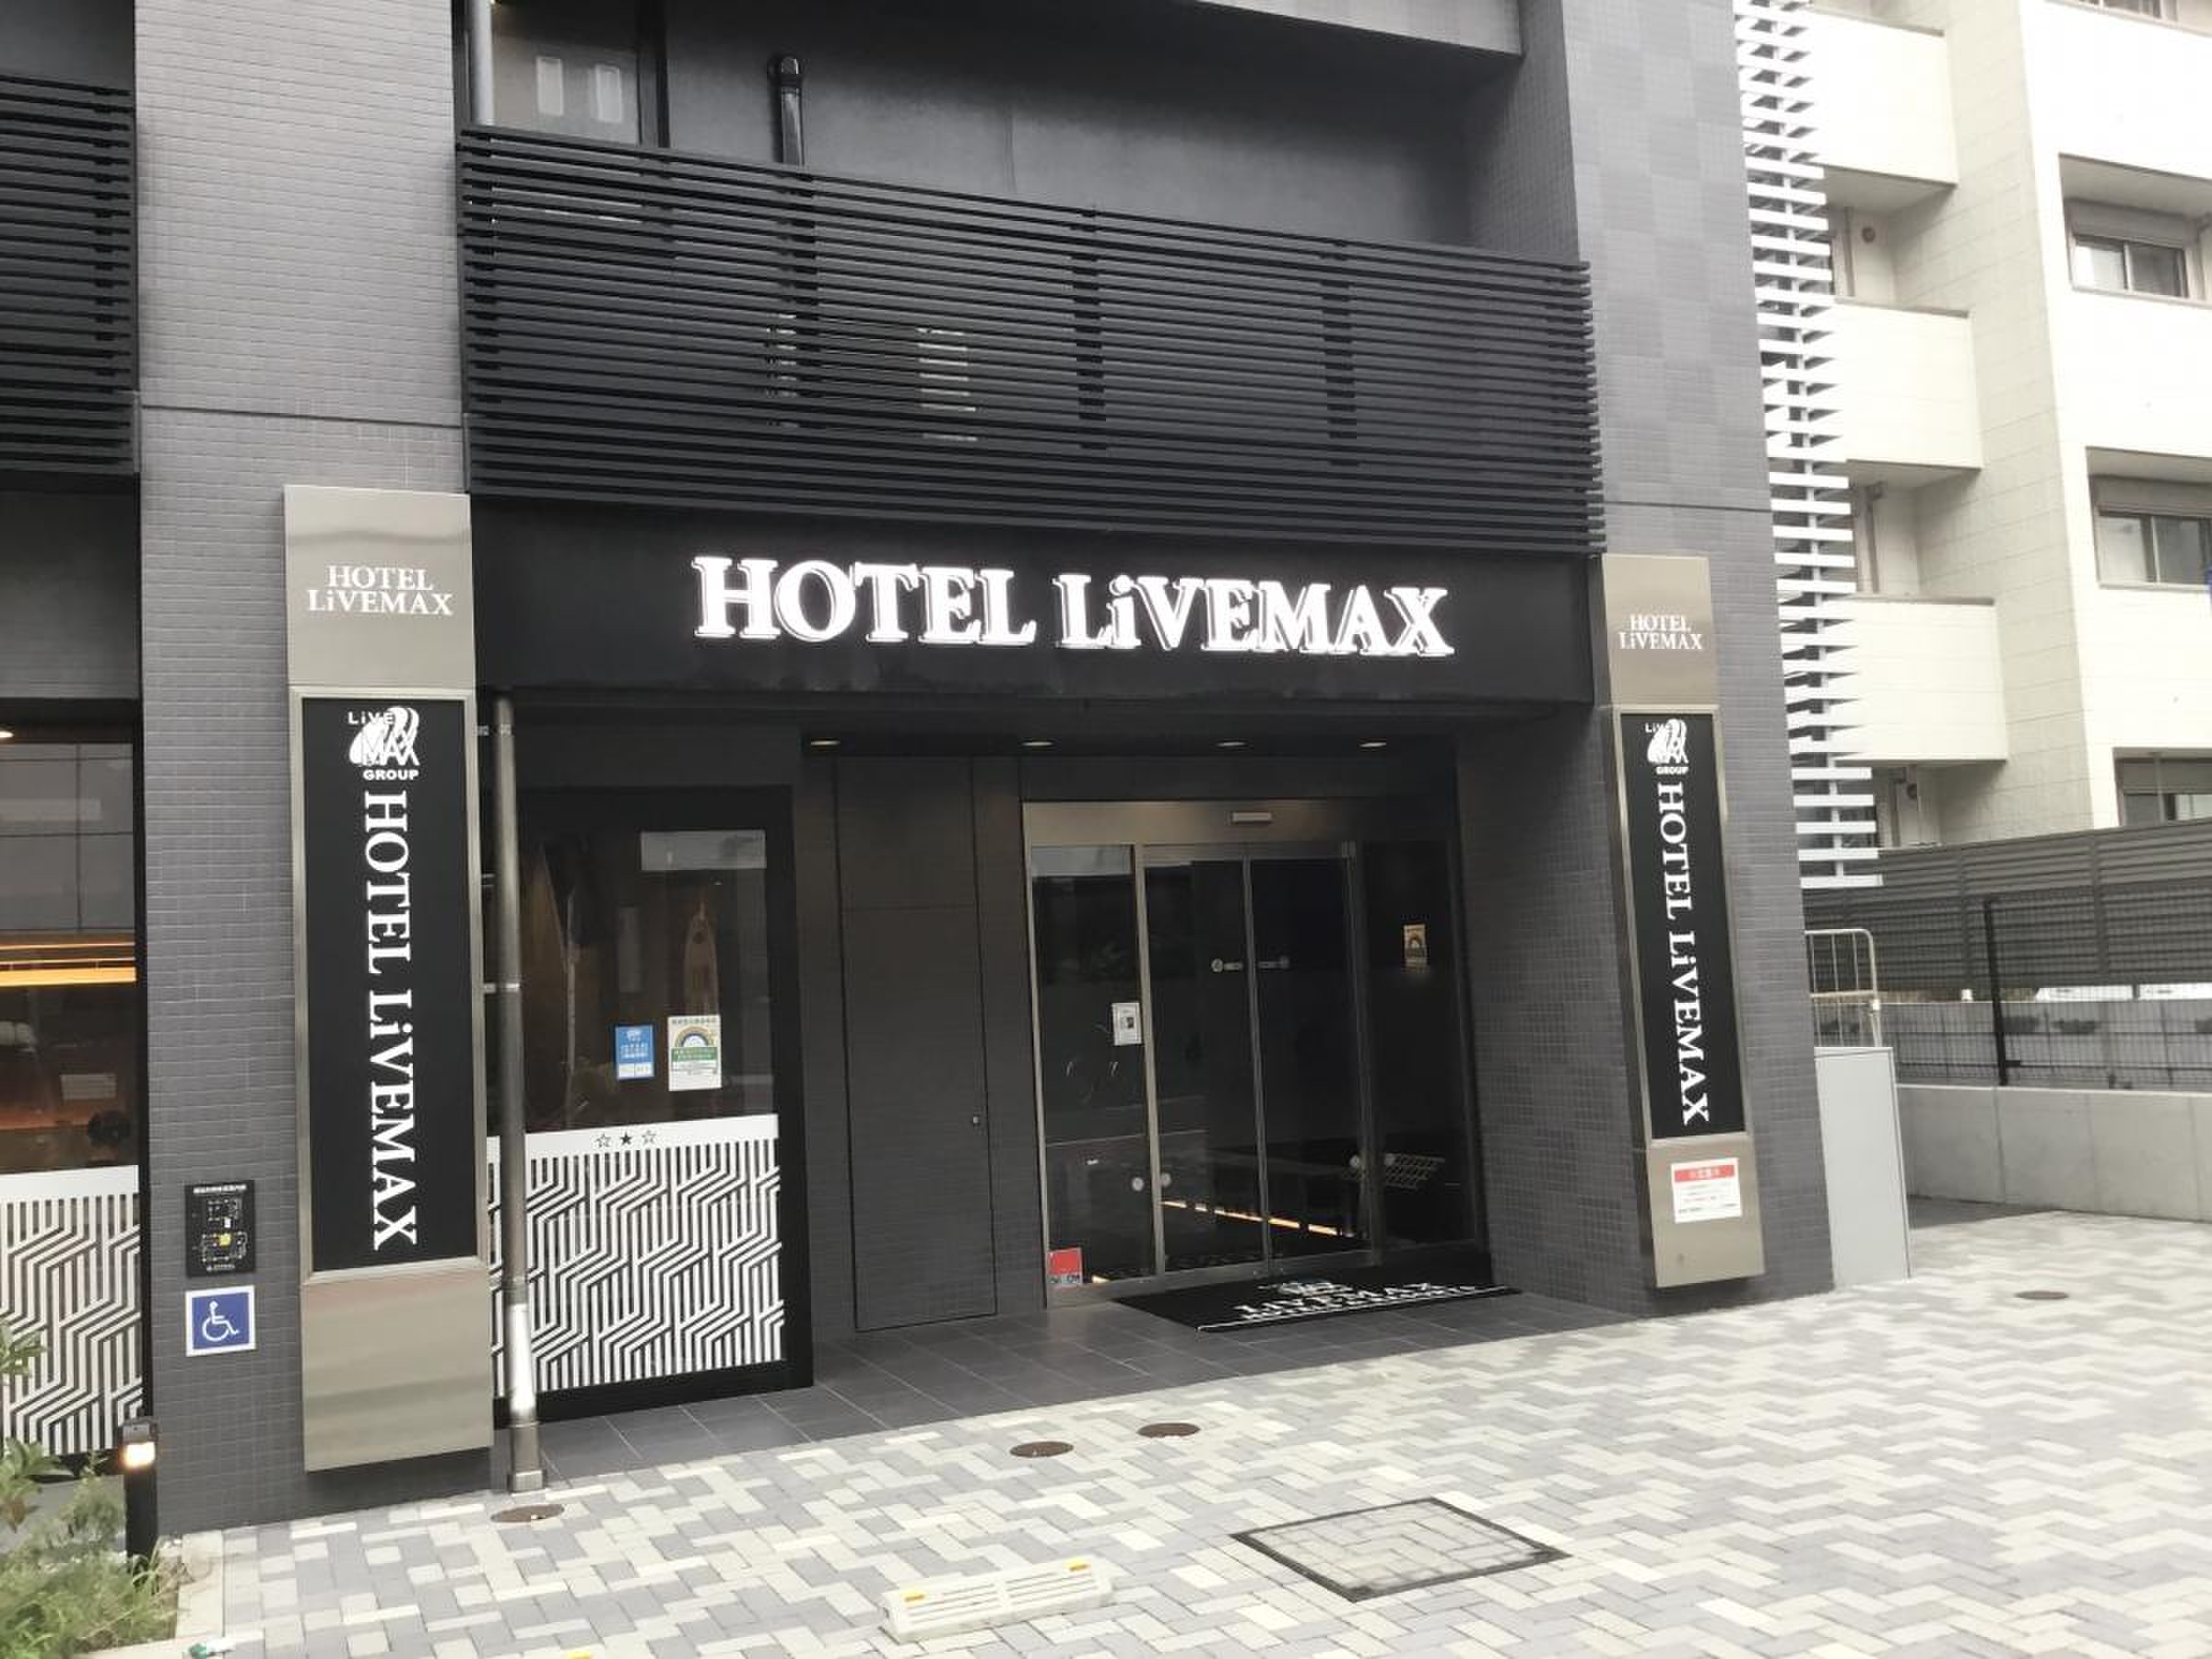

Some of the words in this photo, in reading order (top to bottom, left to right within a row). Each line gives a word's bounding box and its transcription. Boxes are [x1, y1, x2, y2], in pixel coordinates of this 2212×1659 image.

[307, 589, 453, 616] LiVEMAX
[326, 565, 433, 590] HOTEL
[691, 555, 1037, 646] HOTEL
[1053, 573, 1454, 657] LiVEMAX
[1630, 614, 1691, 632] HOTEL
[363, 769, 419, 781] GROUP
[364, 790, 411, 974] HOTEL
[1657, 781, 1693, 921] HOTEL
[1668, 930, 1711, 1126] LiVEMAX
[369, 988, 418, 1252] LiVEMAX
